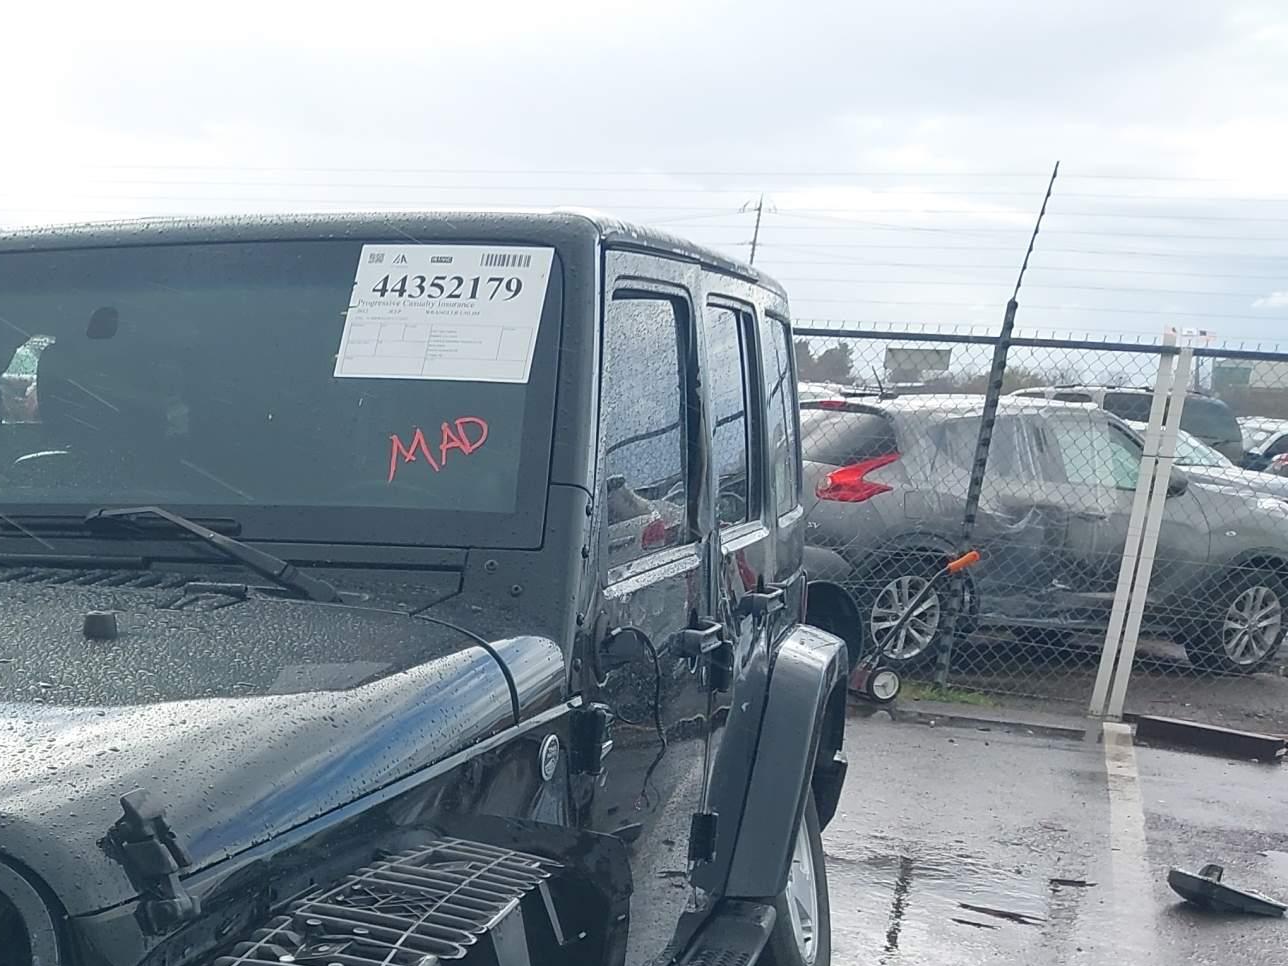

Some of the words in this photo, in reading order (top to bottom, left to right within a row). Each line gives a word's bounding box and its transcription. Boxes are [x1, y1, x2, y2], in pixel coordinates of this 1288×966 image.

[372, 274, 523, 301] 44352179
[358, 299, 400, 307] Progressive
[388, 416, 488, 484] MAD
